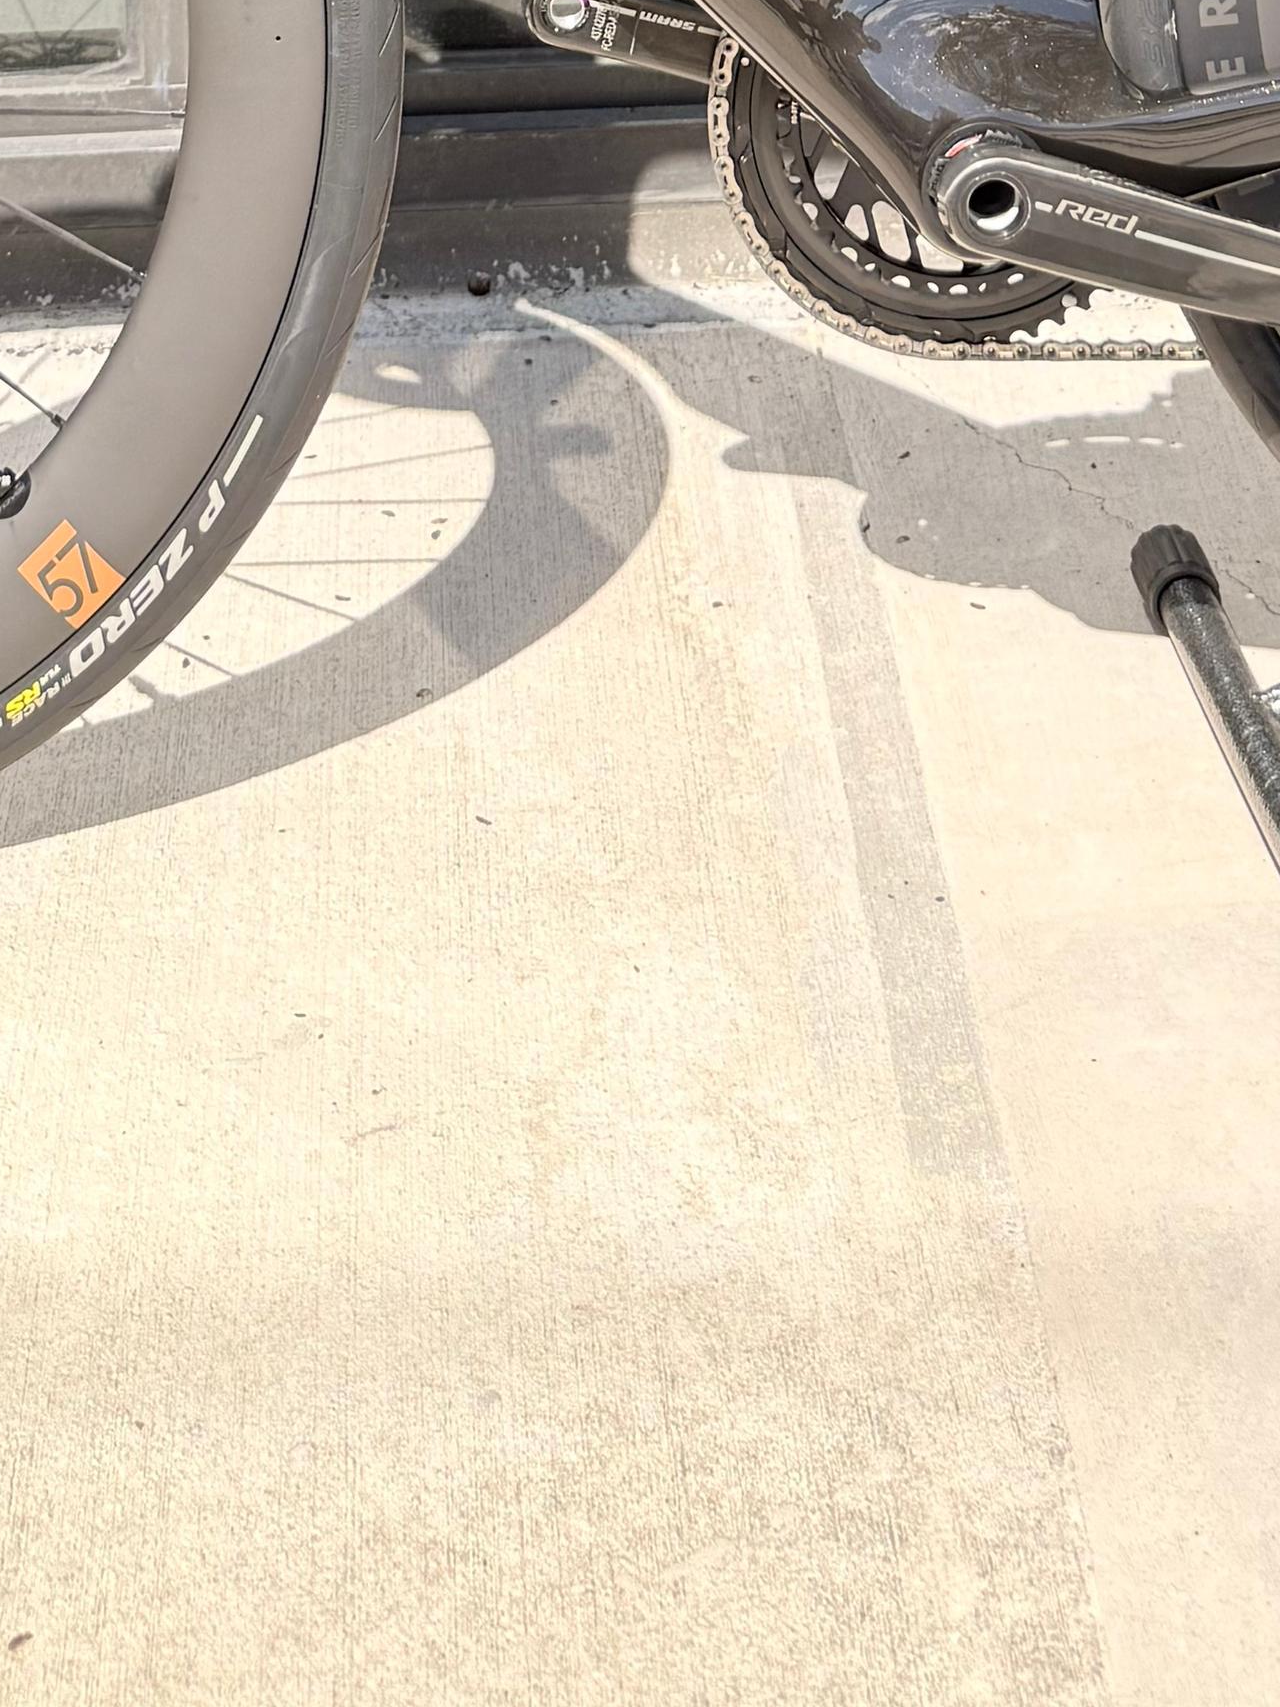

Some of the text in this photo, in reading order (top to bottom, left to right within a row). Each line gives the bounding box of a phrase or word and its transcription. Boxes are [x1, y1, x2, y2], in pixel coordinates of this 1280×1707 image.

[638, 10, 697, 32] SRAM
[1055, 198, 1139, 236] Red
[198, 478, 226, 533] P
[36, 537, 100, 619] 57
[68, 527, 195, 679] ZERO
[4, 679, 43, 722] RS
